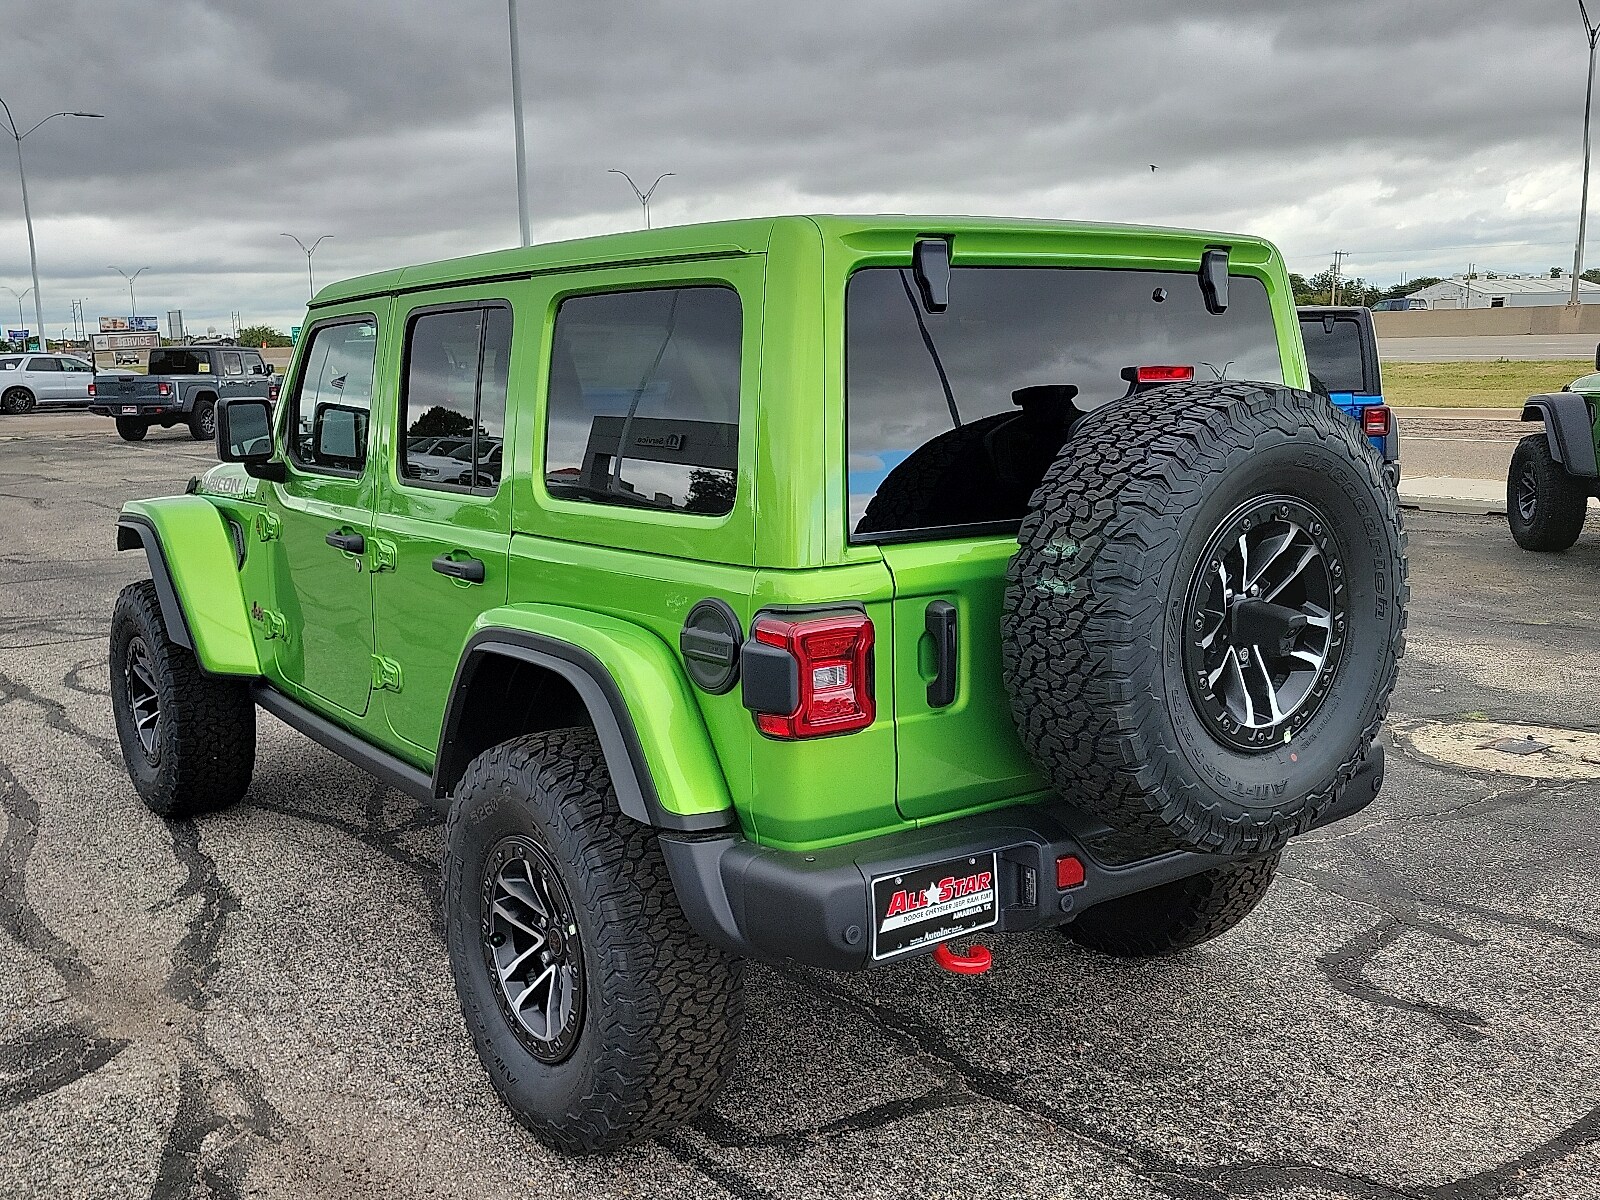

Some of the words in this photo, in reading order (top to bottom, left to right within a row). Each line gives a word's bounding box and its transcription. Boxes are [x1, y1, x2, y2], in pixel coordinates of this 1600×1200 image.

[116, 337, 150, 347] SERVICE
[938, 871, 992, 903] STAR
[903, 911, 924, 923] DODGE
[925, 903, 953, 917] CHRYSLER
